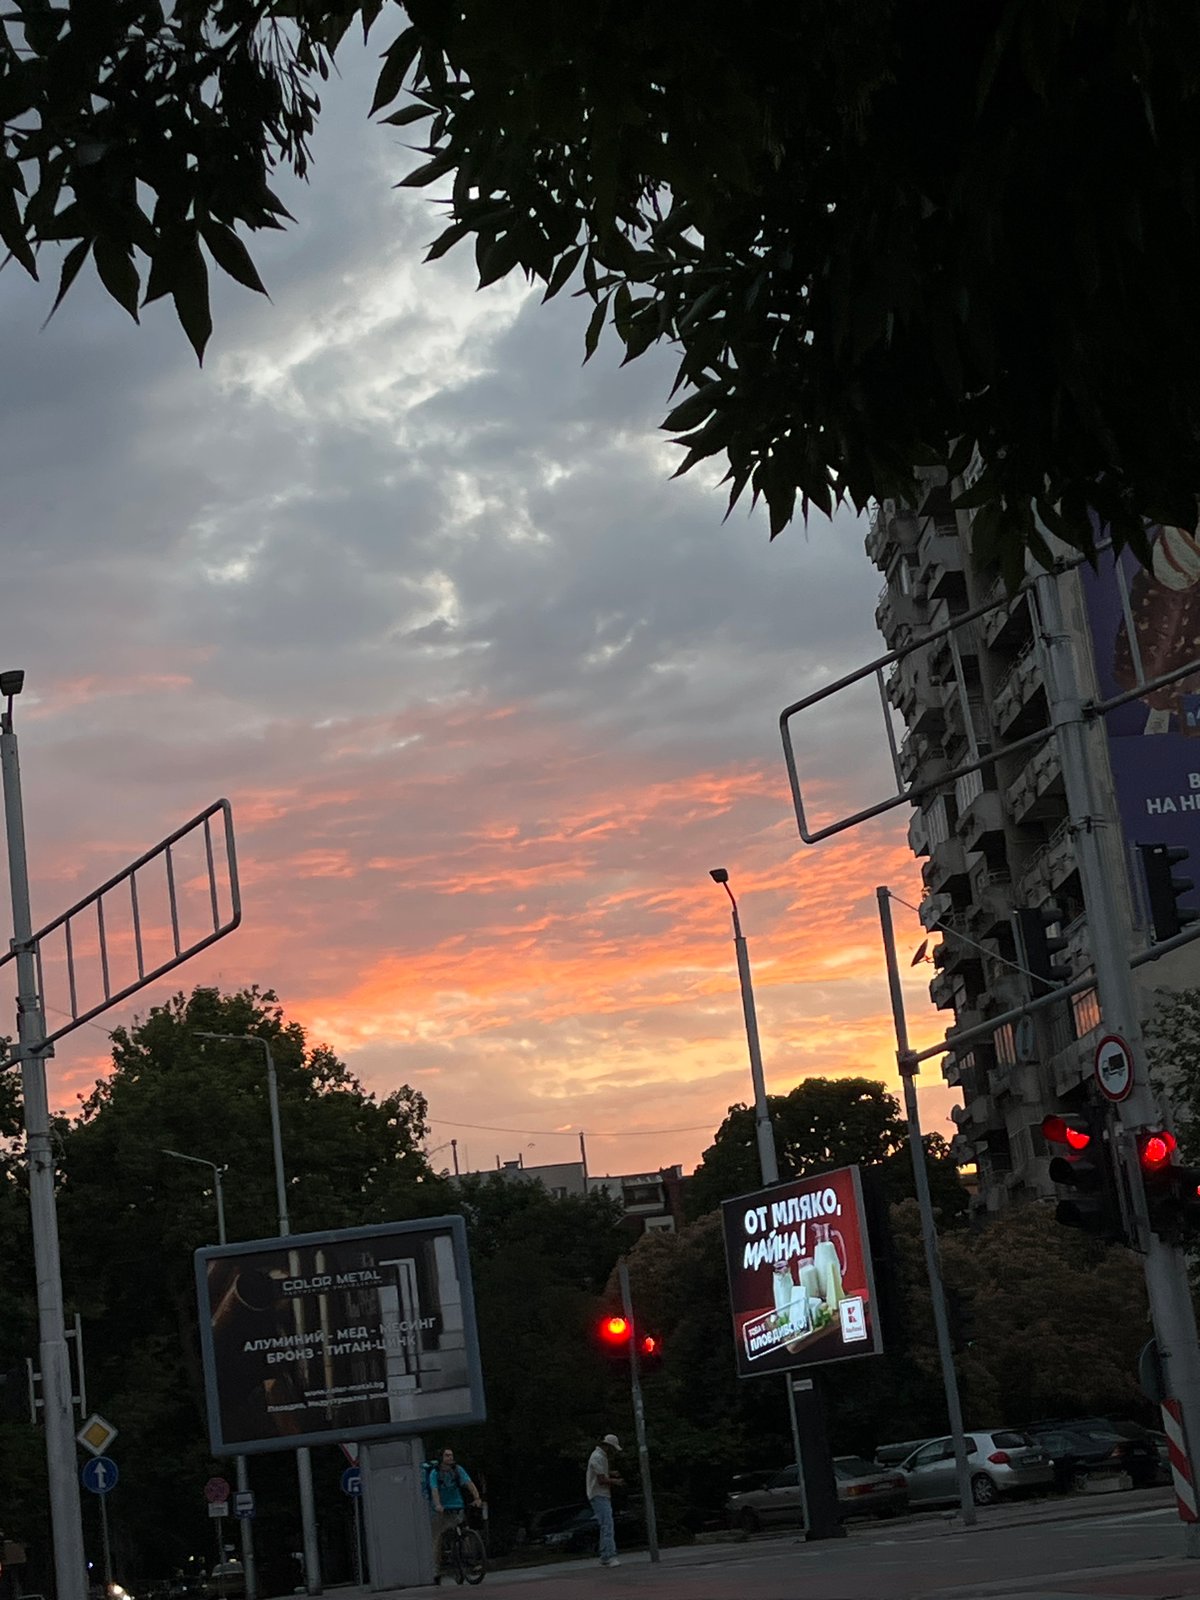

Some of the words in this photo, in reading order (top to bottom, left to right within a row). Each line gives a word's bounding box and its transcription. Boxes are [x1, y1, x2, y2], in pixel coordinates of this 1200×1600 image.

[1146, 796, 1177, 815] НА
[744, 1206, 768, 1235] ОТ
[771, 1187, 842, 1228] МЛЯКО,
[744, 1222, 807, 1271] МАЙНА!
[282, 1275, 332, 1291] COLOR
[335, 1270, 381, 1284] METAL
[244, 1330, 325, 1352] АЛУМИНИЙ
[336, 1326, 369, 1341] МЕД
[379, 1317, 437, 1335] МЕСИНГ
[266, 1348, 315, 1364] БРОНЗ
[325, 1335, 417, 1357] ТИТАН-ЦИНК
